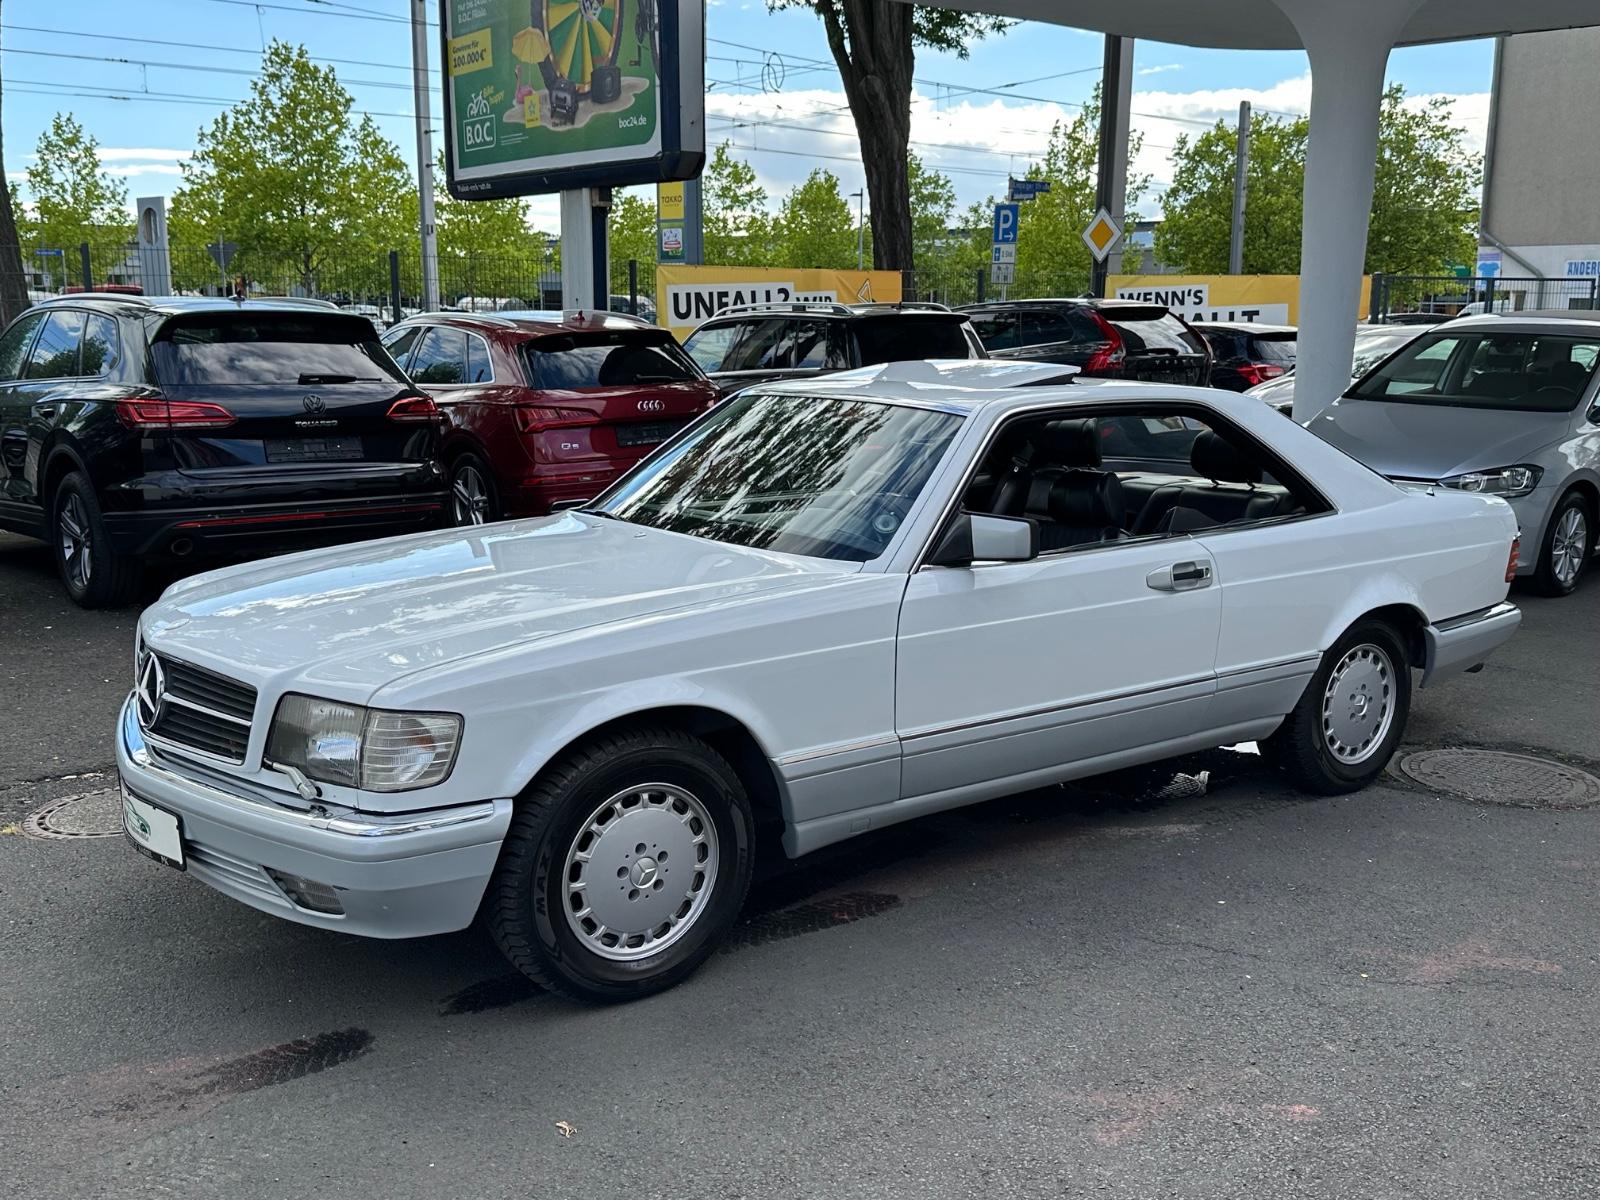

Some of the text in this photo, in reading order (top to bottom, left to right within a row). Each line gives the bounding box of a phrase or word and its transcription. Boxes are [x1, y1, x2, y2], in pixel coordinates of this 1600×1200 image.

[466, 121, 493, 146] B.O.C.
[618, 114, 647, 129] boc24.de
[1000, 209, 1012, 240] P
